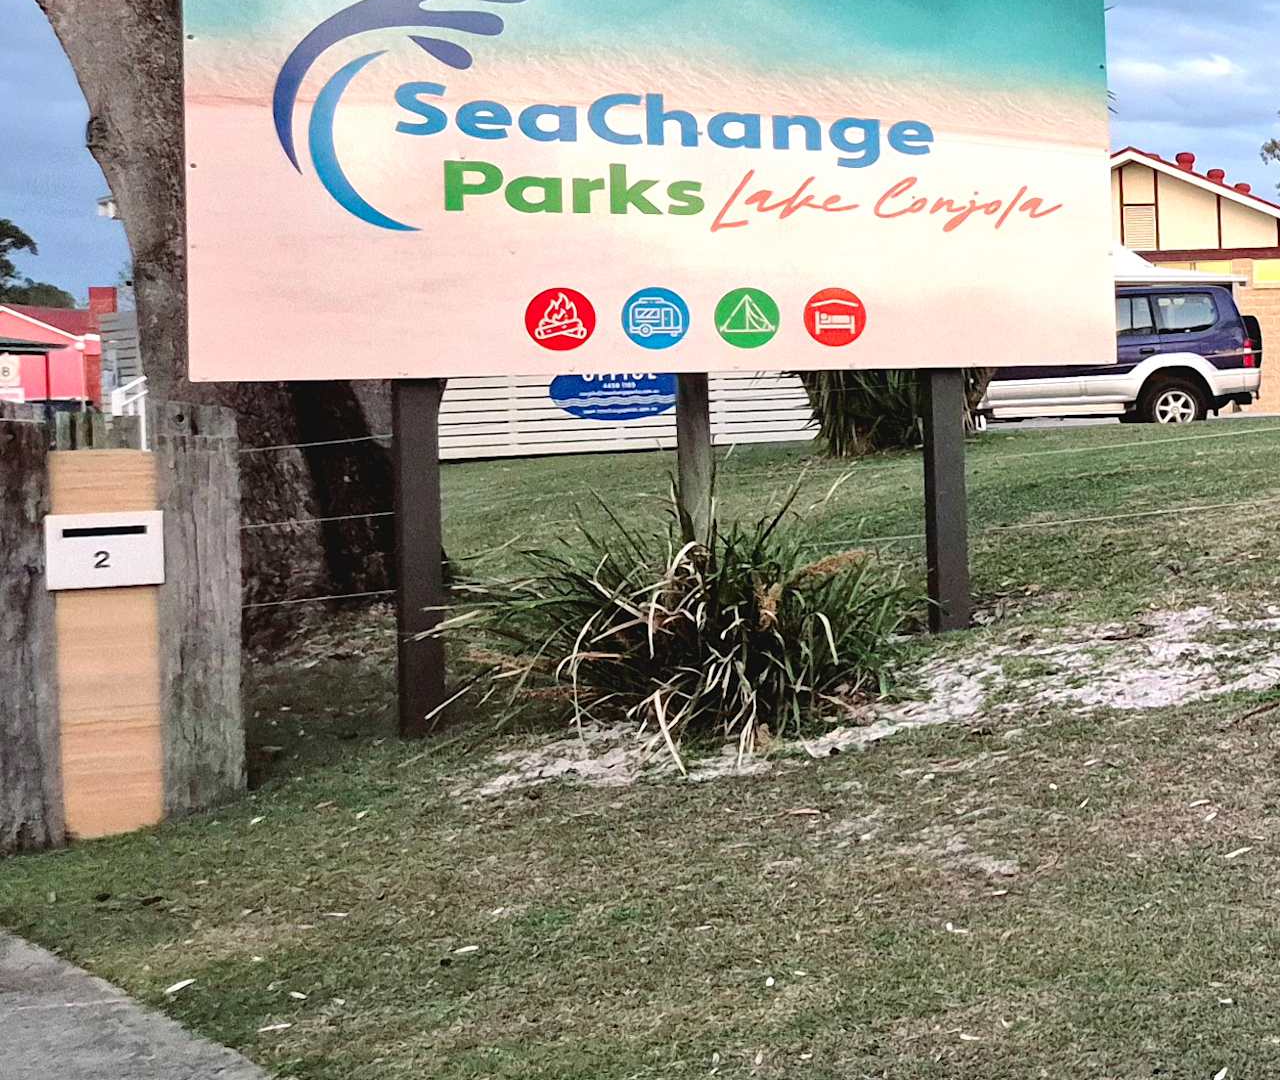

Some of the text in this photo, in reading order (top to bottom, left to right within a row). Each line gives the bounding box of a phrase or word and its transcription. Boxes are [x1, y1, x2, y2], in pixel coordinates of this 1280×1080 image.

[395, 83, 934, 168] SeaChange
[444, 161, 1063, 233] Parks Lake Conjola
[94, 550, 111, 569] 2
